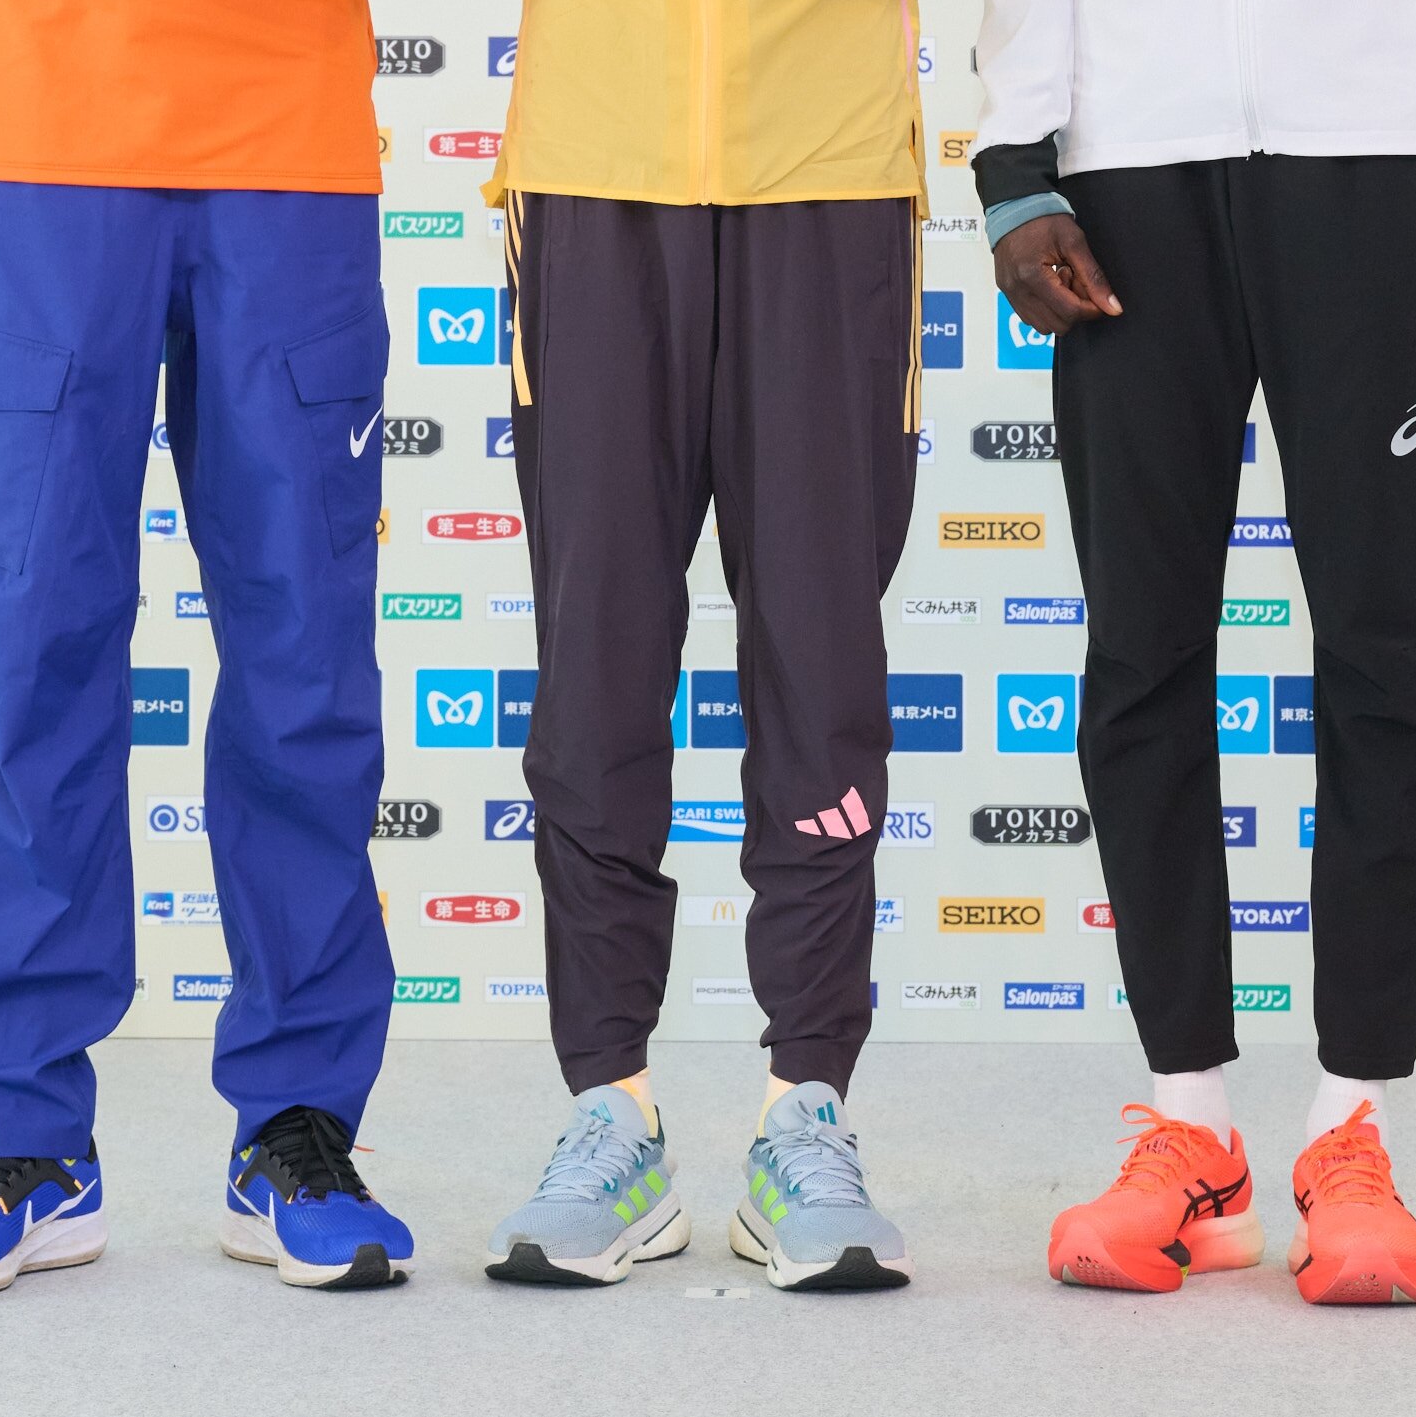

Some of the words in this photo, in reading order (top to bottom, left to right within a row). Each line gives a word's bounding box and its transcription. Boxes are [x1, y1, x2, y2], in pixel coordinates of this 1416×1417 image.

[985, 425, 1057, 444] TOKI
[994, 445, 1055, 459] インカラ
[943, 522, 1041, 540] SEIKO
[378, 803, 428, 823] KIO
[672, 808, 711, 819] CARI
[714, 808, 746, 820] SWE
[375, 823, 418, 837] カラミ
[435, 900, 511, 918] 第一生命
[1233, 989, 1288, 1008] スクリン
